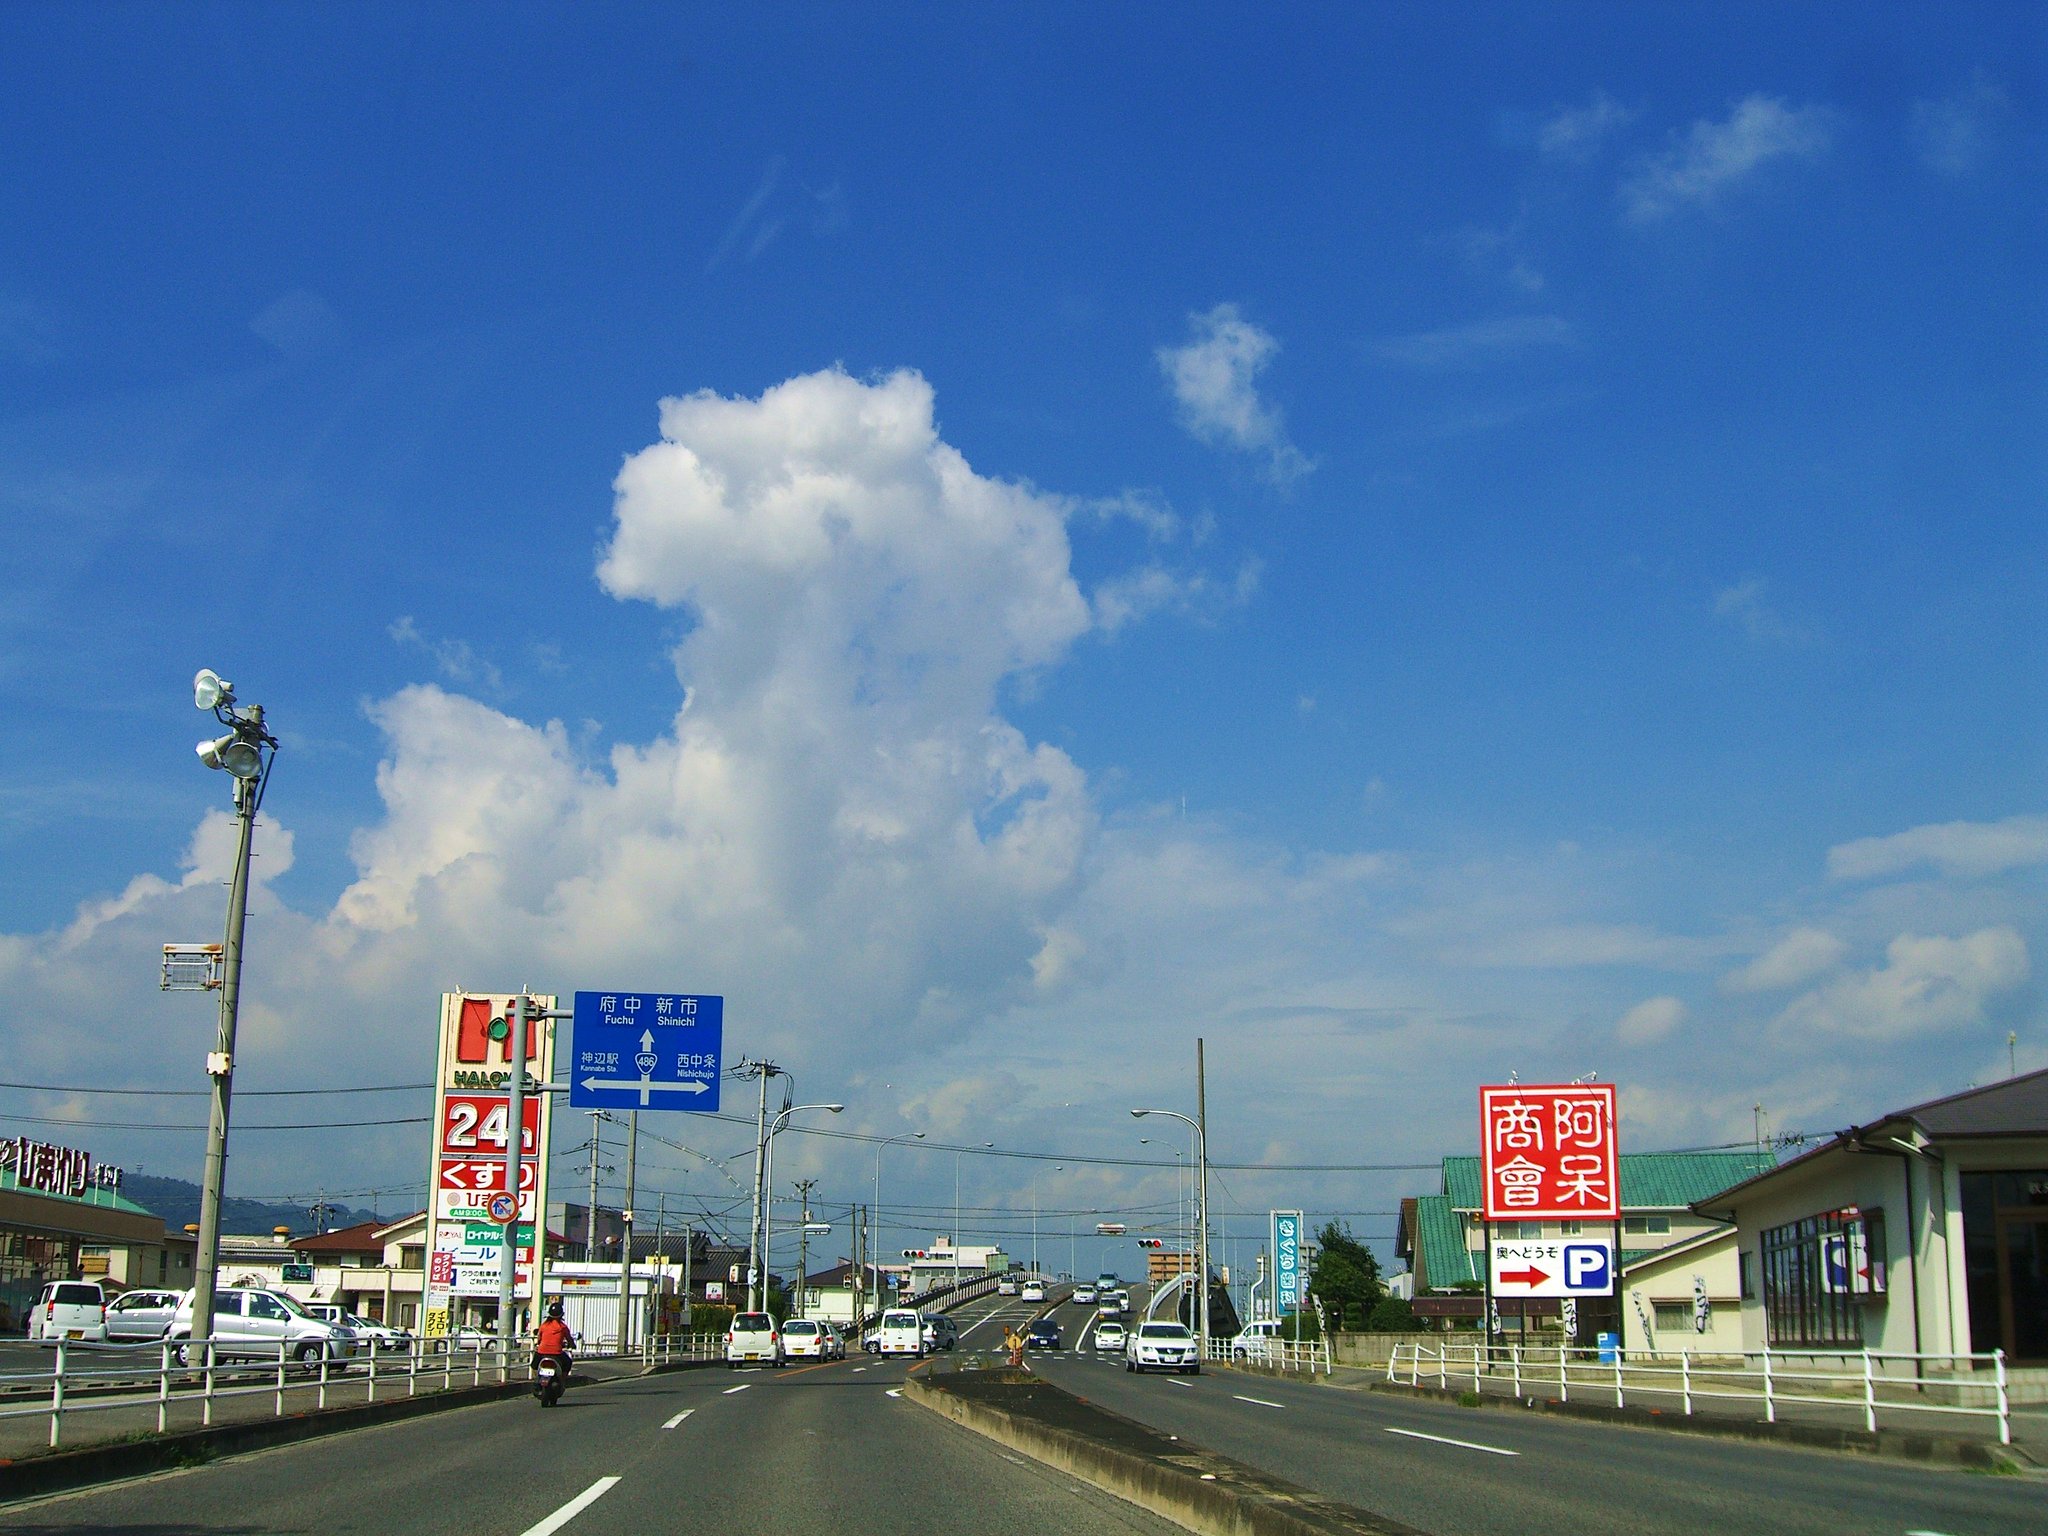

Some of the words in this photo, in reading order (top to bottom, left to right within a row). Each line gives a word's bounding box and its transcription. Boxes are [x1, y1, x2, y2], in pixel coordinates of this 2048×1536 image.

[599, 996, 641, 1014] 府中
[655, 997, 698, 1015] 新市
[605, 1015, 635, 1025] Fuchu
[657, 1016, 695, 1027] Shinichi
[581, 1052, 619, 1065] 神辺駅
[638, 1056, 654, 1067] 486
[677, 1053, 716, 1068] 西中条
[580, 1064, 605, 1073] Kannabe
[606, 1065, 619, 1073] Sta.
[677, 1069, 715, 1079] Nishichujo
[466, 1192, 528, 1208] ひまり
[1496, 1246, 1559, 1259] 奥へどうぞ
[432, 1257, 441, 1280] のりば
[1569, 1249, 1605, 1285] P
[427, 1312, 436, 1336] タクシー
[436, 1310, 446, 1334] イエロー
